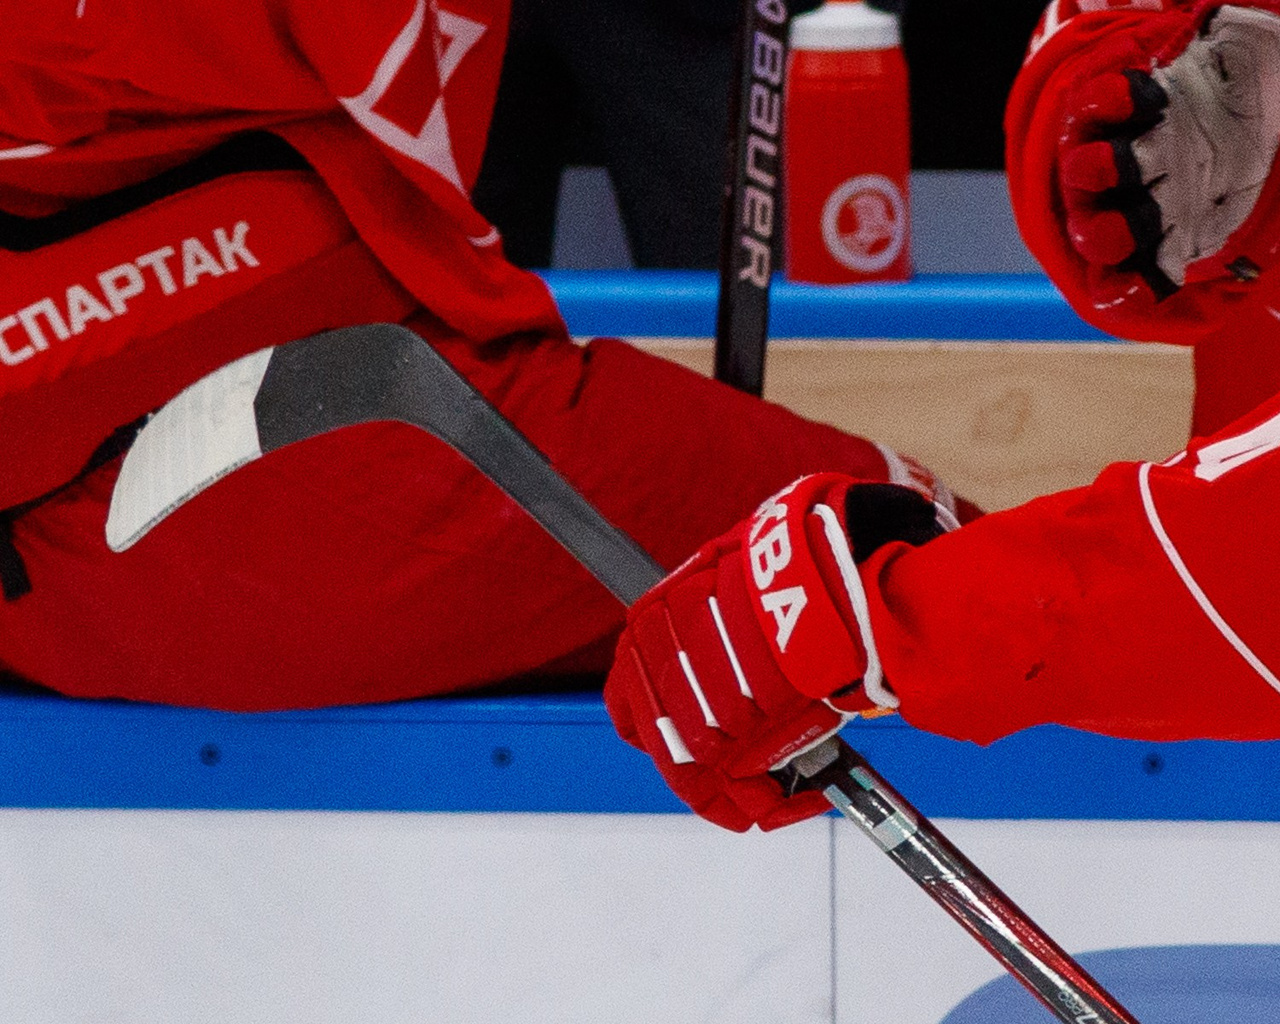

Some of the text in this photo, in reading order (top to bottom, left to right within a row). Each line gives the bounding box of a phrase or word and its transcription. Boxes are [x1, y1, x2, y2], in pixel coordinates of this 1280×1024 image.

[741, 29, 785, 290] BAUER
[0, 220, 261, 366] СПАРТАК
[749, 480, 809, 654] КВА
